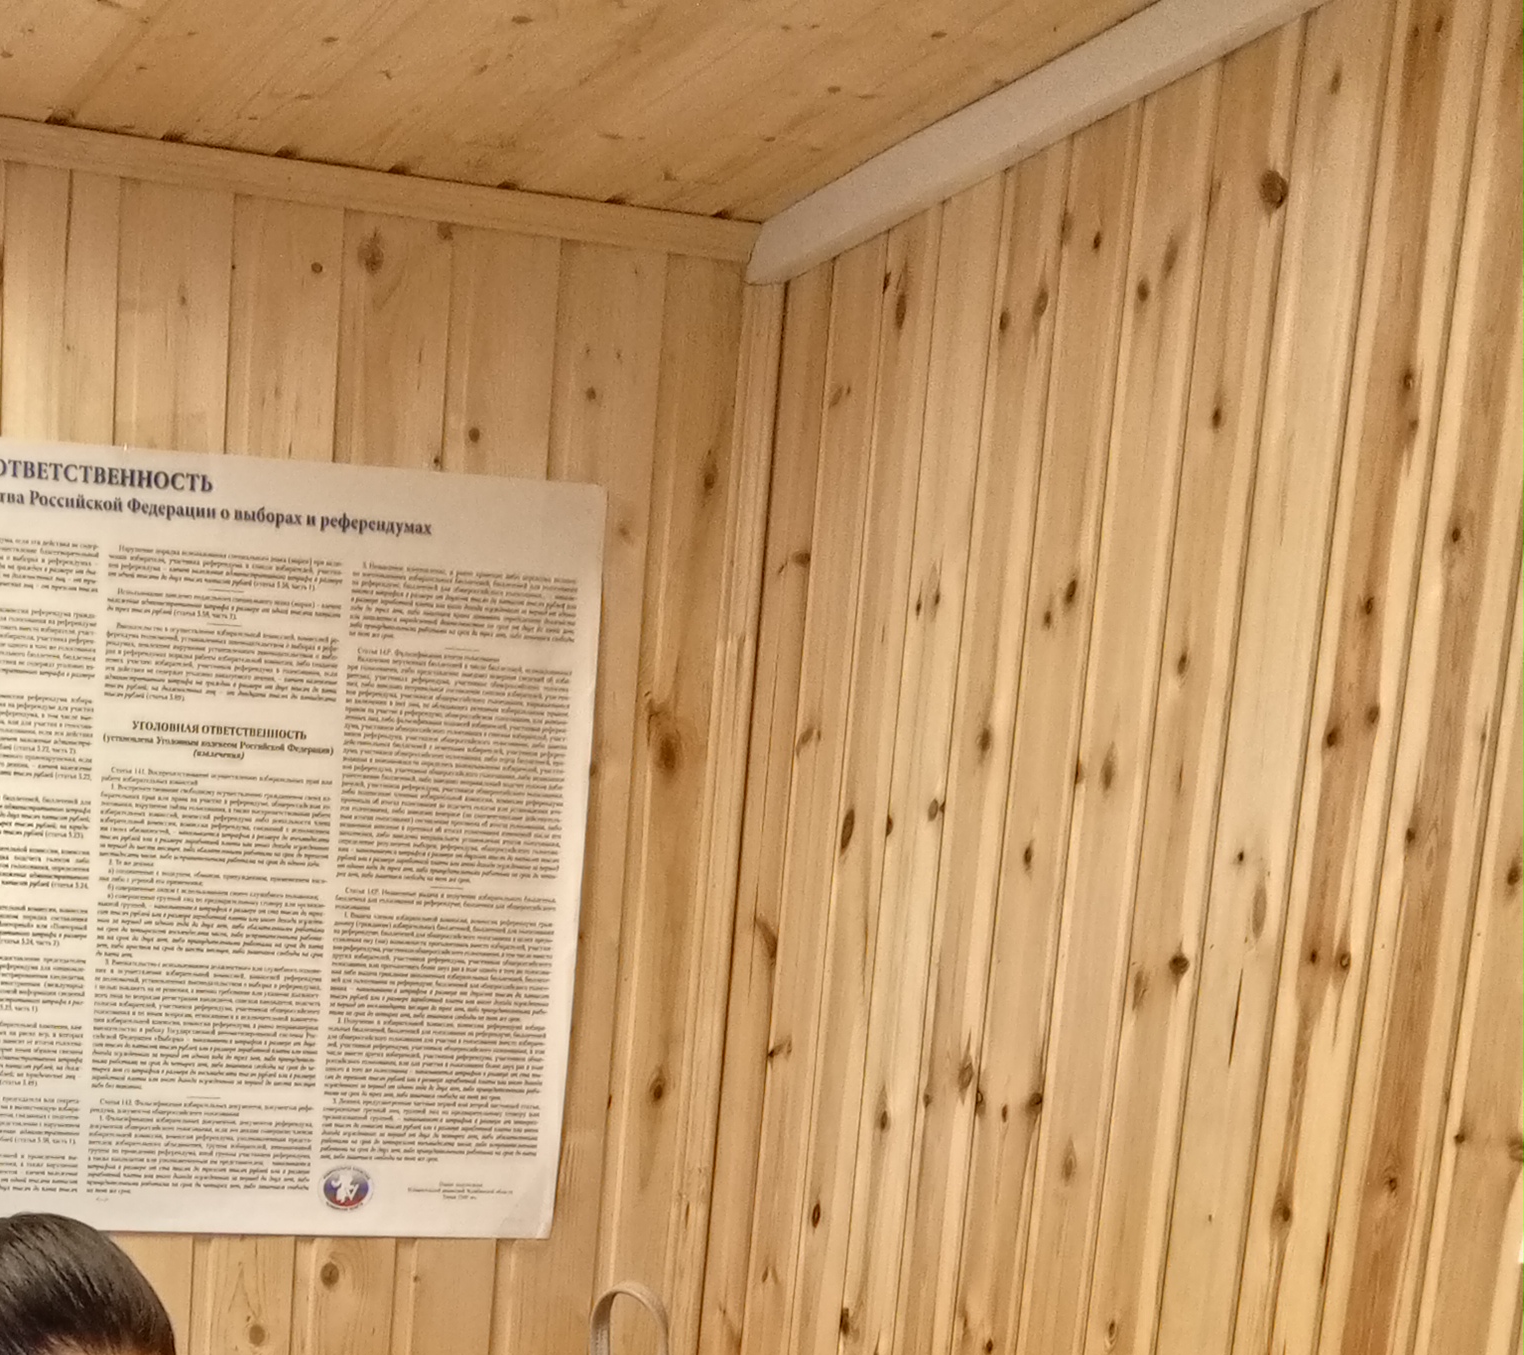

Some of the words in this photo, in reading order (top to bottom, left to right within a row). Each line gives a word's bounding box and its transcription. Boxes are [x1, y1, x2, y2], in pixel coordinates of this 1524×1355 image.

[29, 490, 123, 513] Российской
[128, 497, 216, 521] Федерации
[220, 508, 230, 519] о
[235, 506, 302, 527] выборах
[306, 515, 316, 527] и
[320, 512, 432, 537] референдумах
[132, 720, 200, 734] УГОЛОВНАЯ
[201, 724, 307, 740] ОТВЕТСТВЕННОСТЬ
